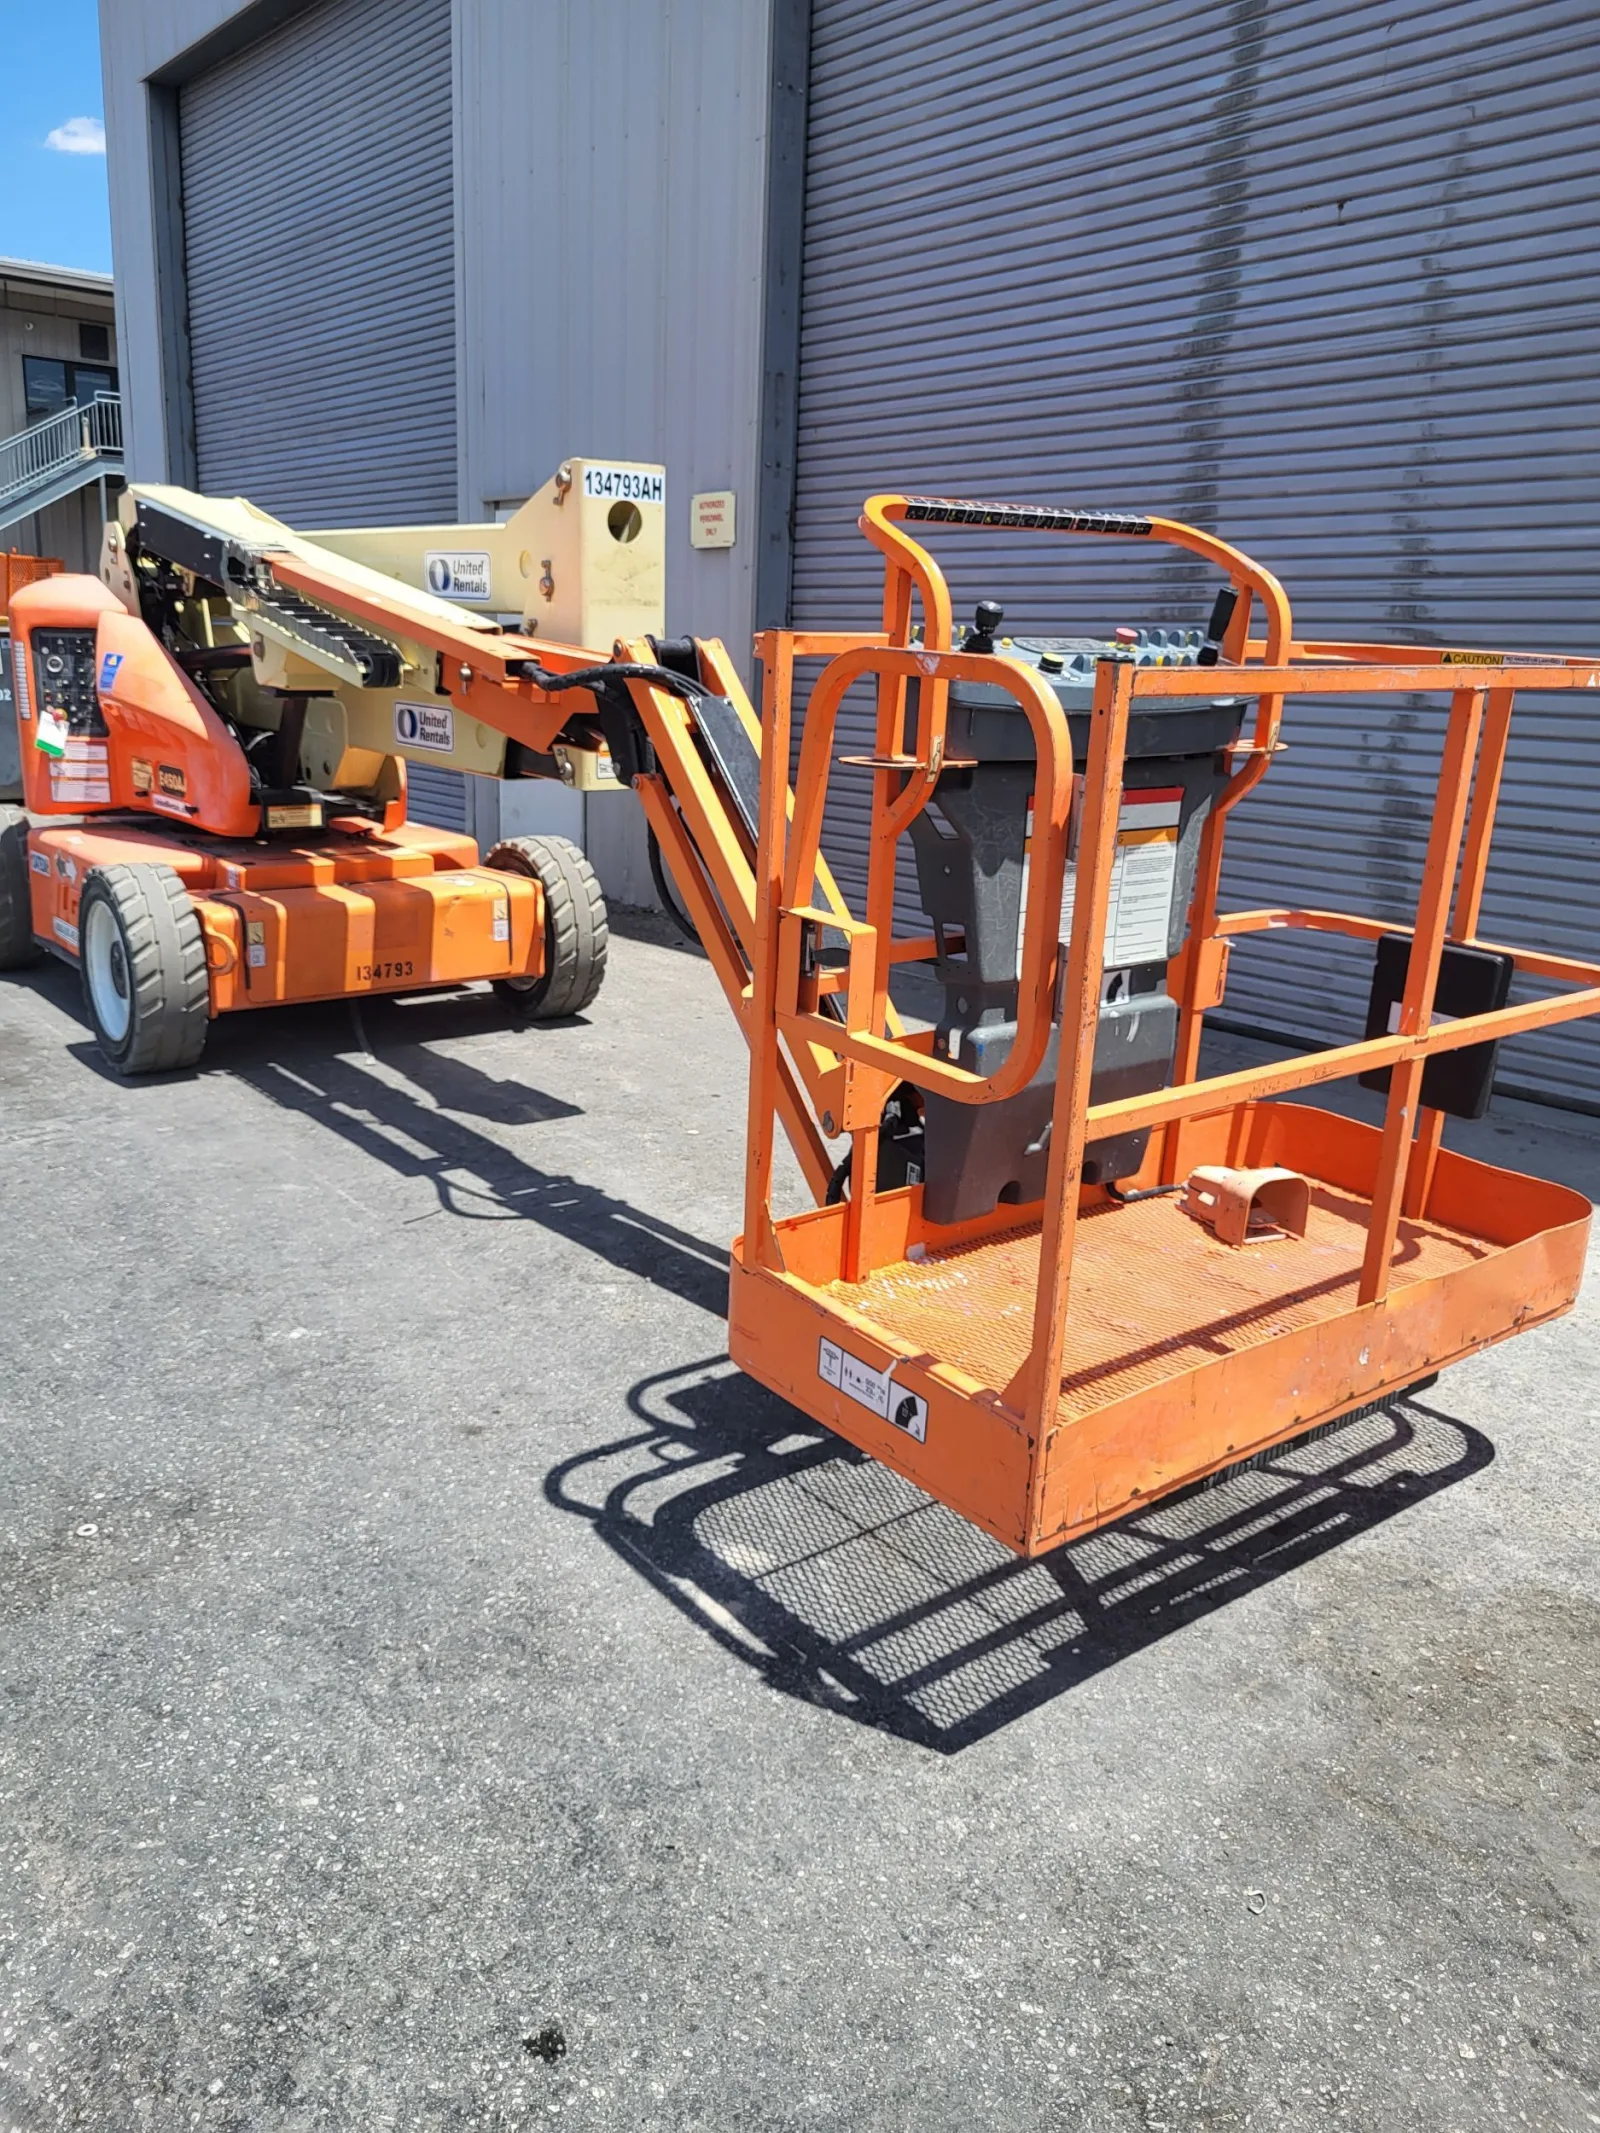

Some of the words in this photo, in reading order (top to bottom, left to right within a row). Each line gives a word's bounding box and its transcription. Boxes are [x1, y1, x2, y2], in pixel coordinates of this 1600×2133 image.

[585, 471, 662, 501] 134793AH
[453, 559, 484, 576] United
[453, 577, 488, 593] Rentals
[1453, 653, 1500, 665] CAUTION
[419, 711, 447, 729] United
[420, 727, 450, 745] Rentals
[357, 961, 413, 981] 134793
